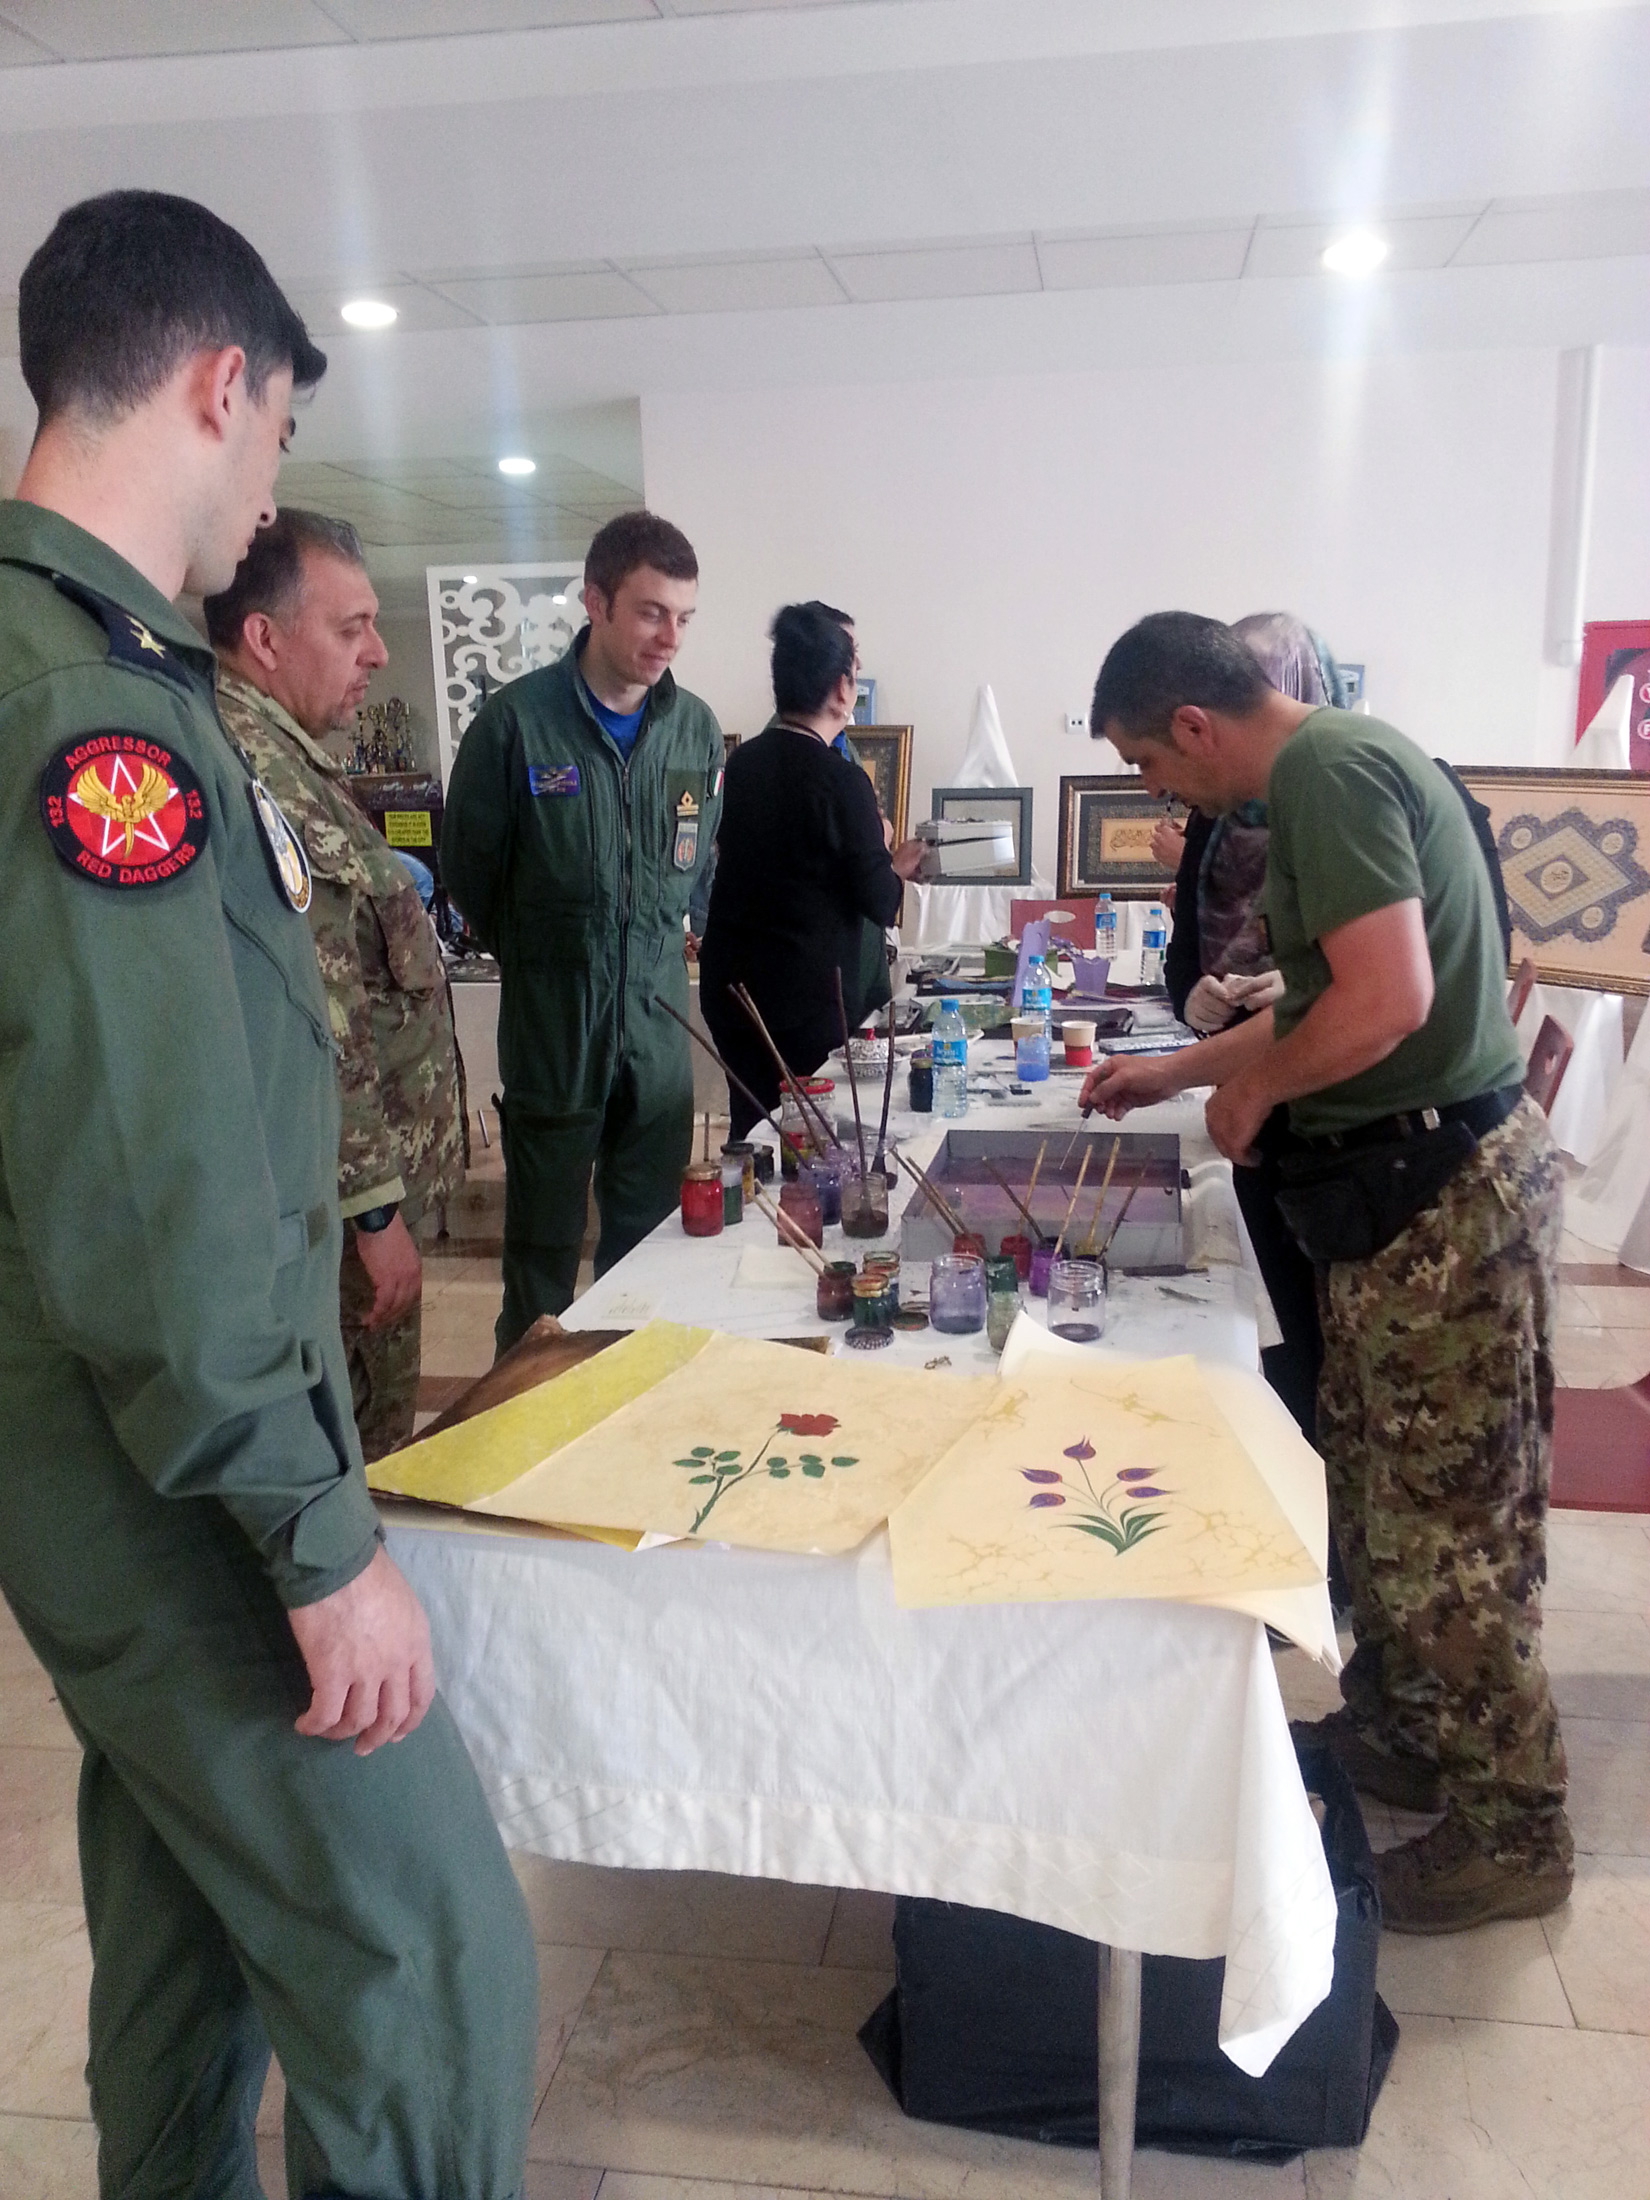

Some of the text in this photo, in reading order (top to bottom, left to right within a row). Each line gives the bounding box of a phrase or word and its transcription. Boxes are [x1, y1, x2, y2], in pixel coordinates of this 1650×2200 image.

[65, 735, 171, 770] AGGRESSOR
[47, 795, 64, 828] 132
[77, 843, 196, 884] RED DAGGERS
